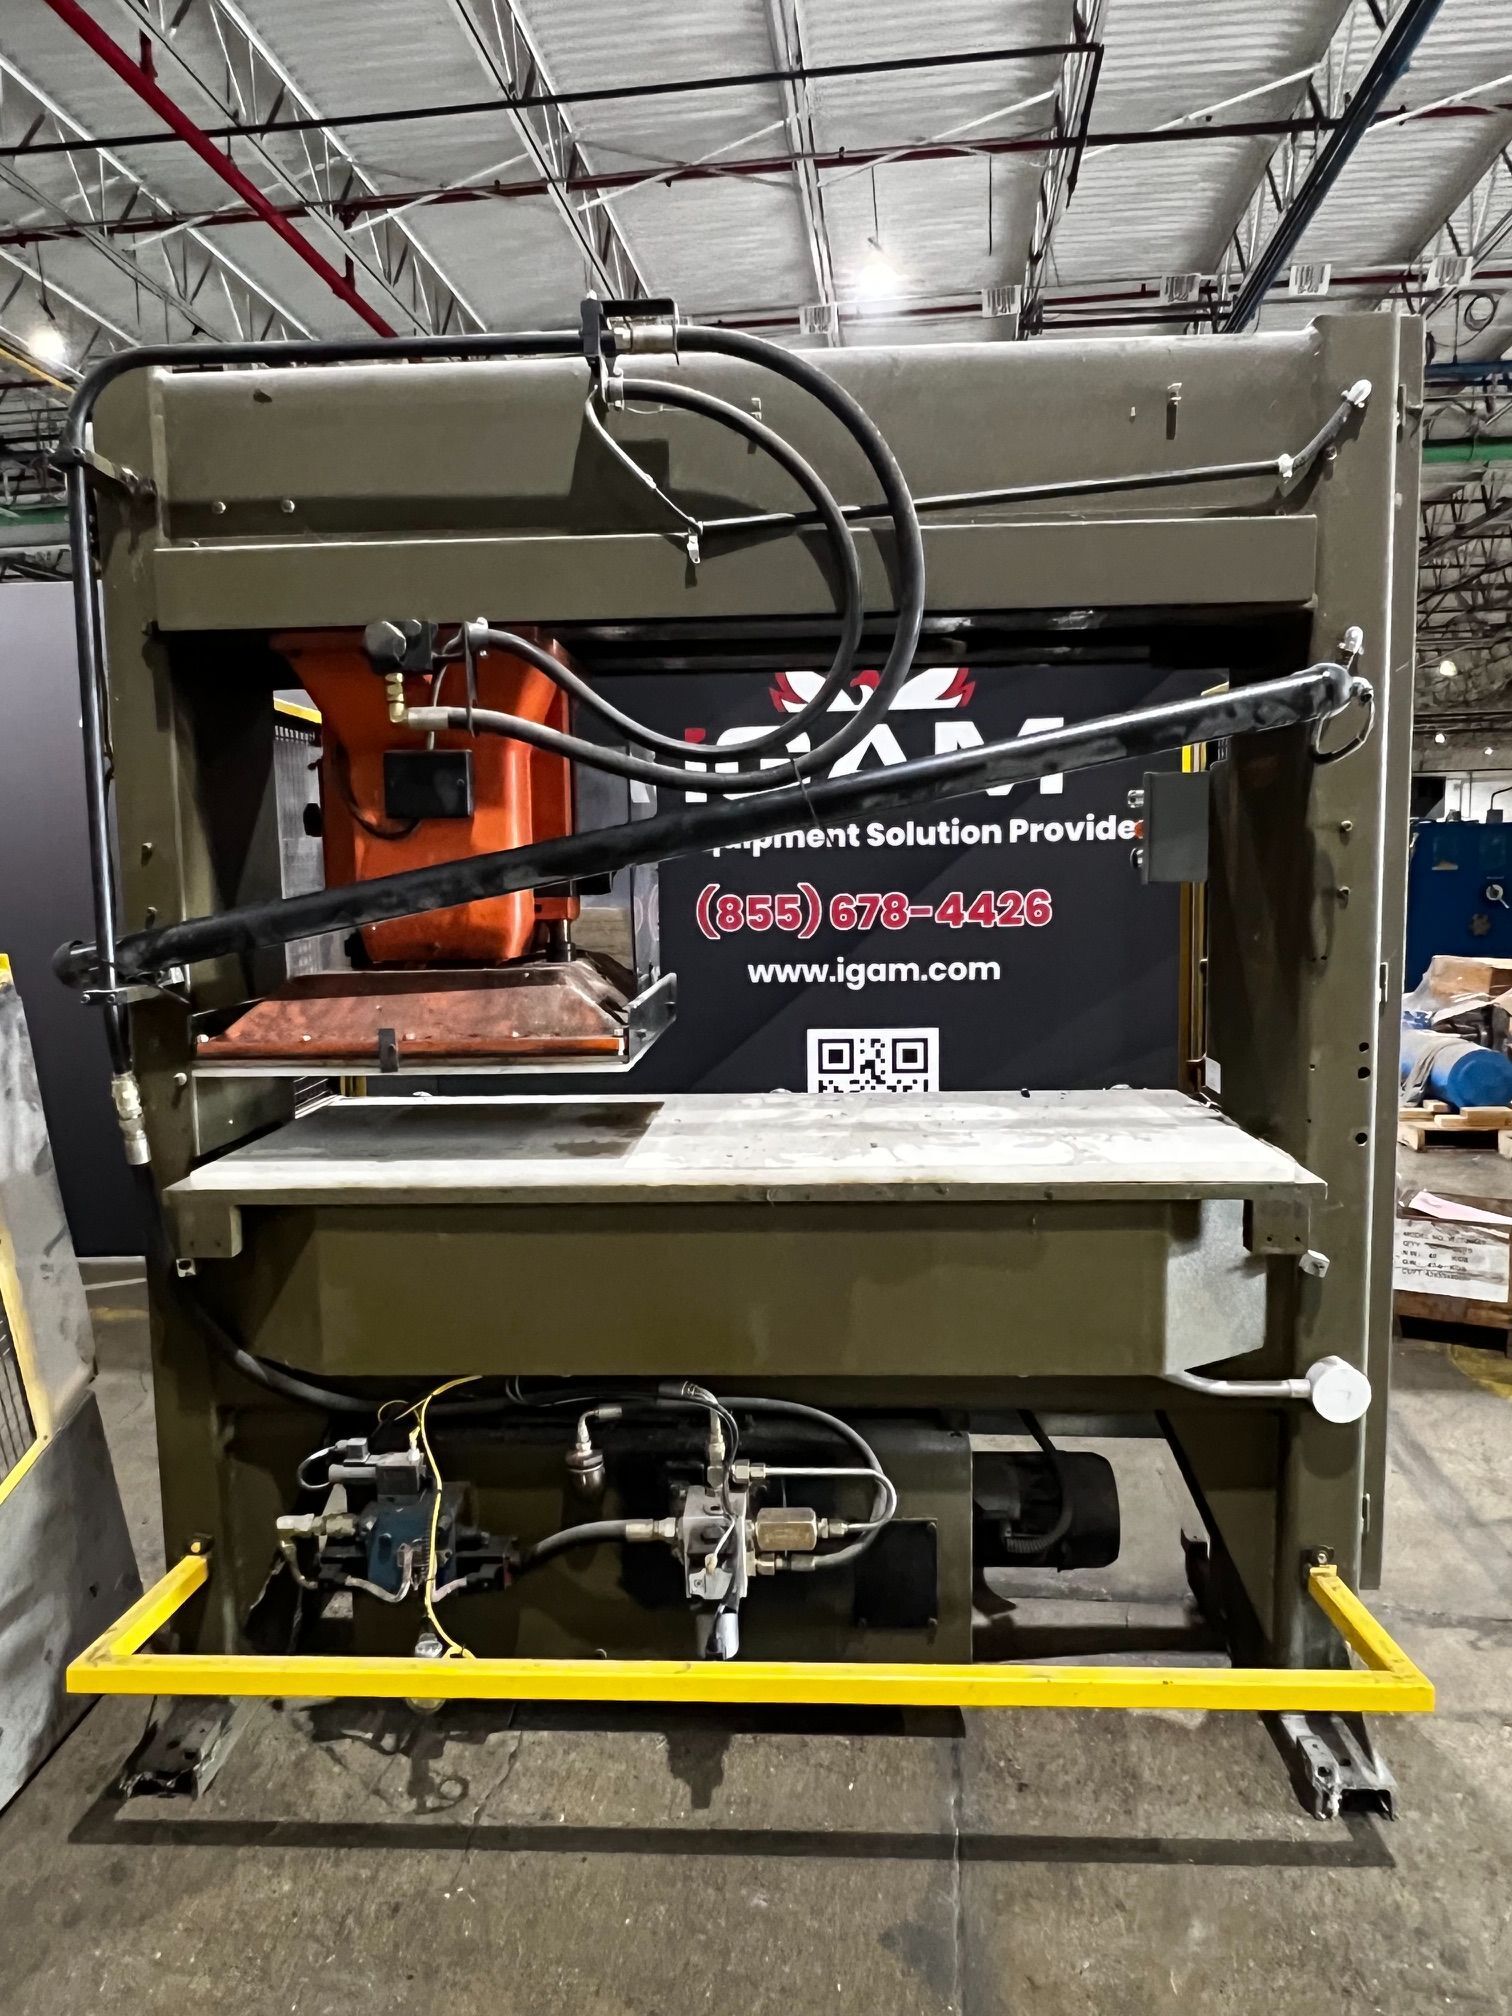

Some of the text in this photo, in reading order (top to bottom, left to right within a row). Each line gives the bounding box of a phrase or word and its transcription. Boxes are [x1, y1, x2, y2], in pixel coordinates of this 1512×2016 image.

[866, 817, 1003, 847] Solution
[695, 882, 1053, 940] (855) 678-4426
[747, 956, 1001, 991] www.igam.com
